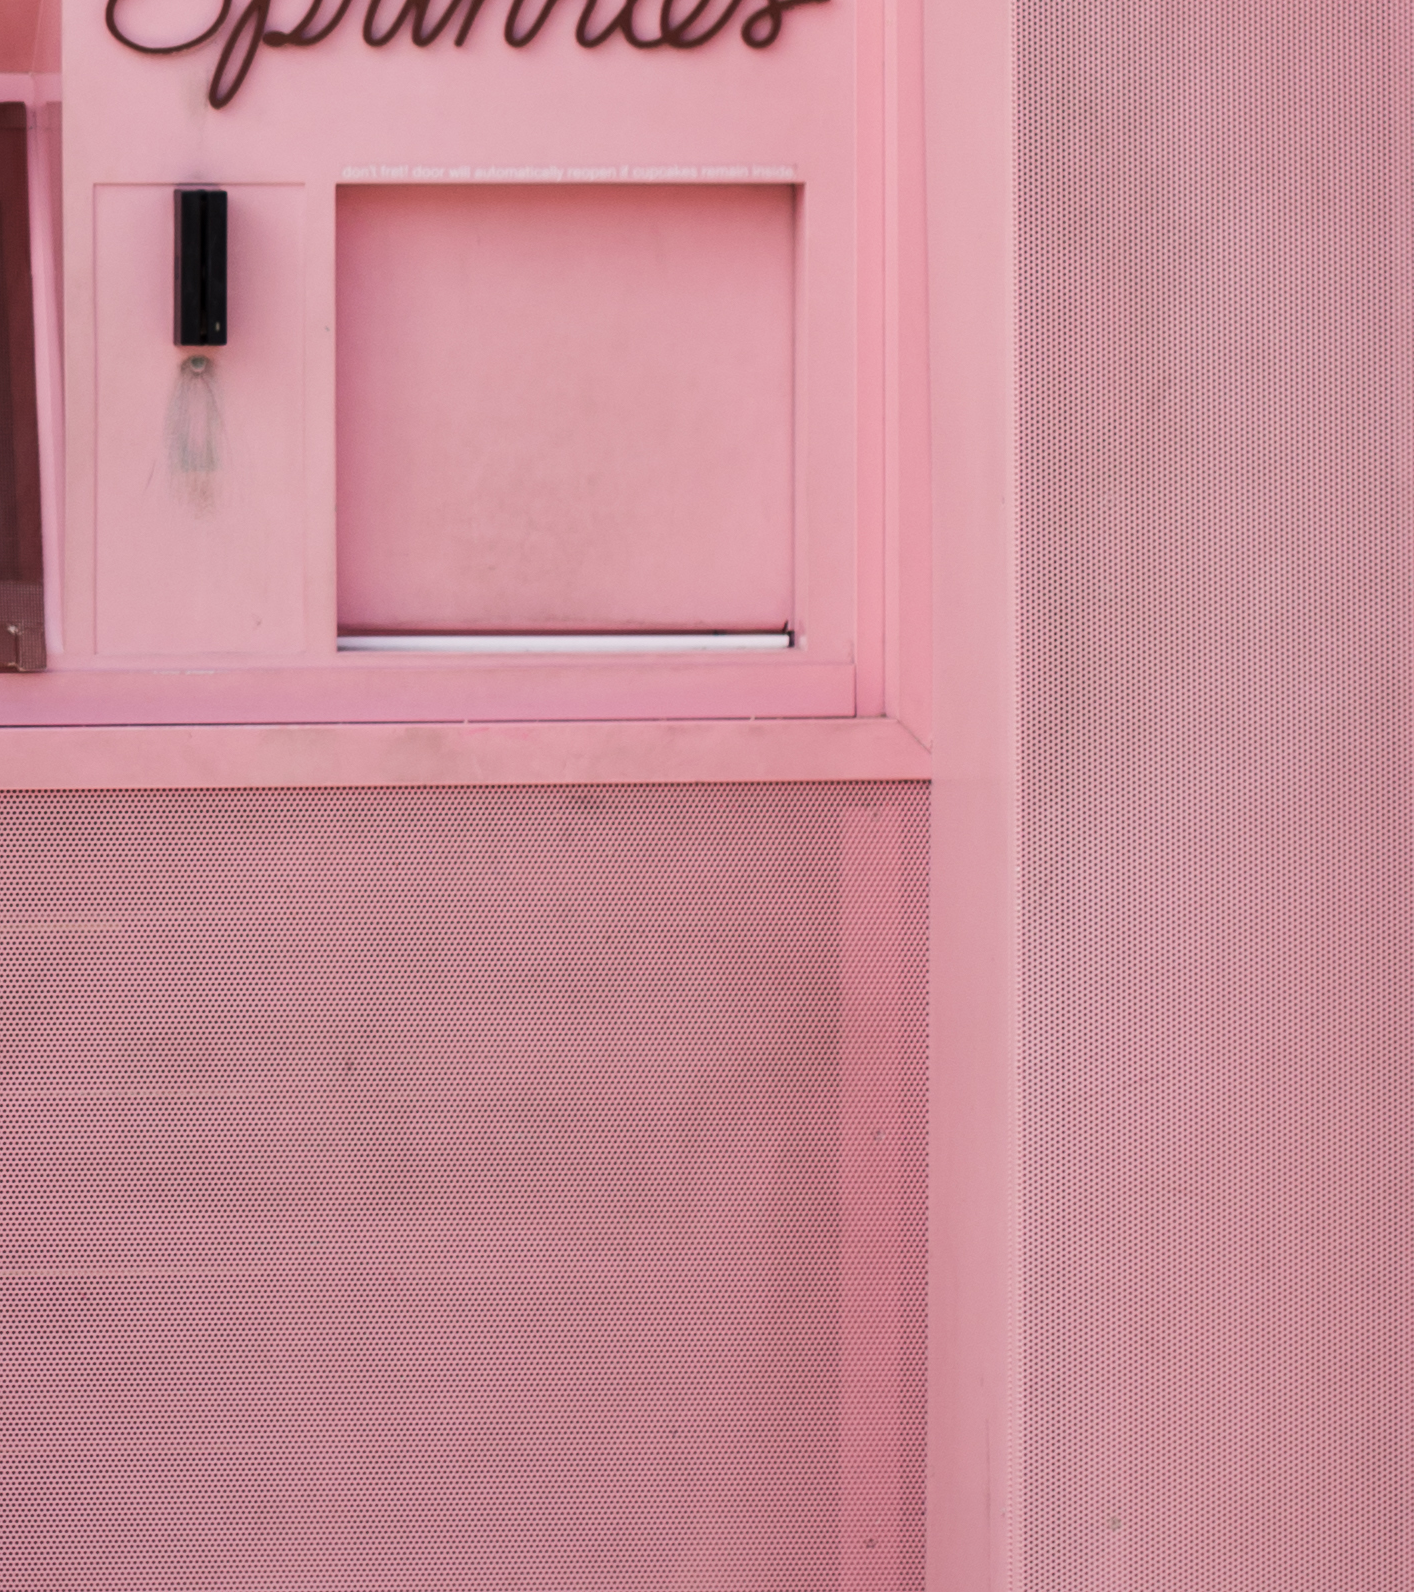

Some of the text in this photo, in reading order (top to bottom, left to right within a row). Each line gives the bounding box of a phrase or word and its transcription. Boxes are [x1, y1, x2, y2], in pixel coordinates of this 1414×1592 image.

[412, 165, 445, 179] door
[449, 165, 470, 179] will
[474, 165, 564, 183] automatically
